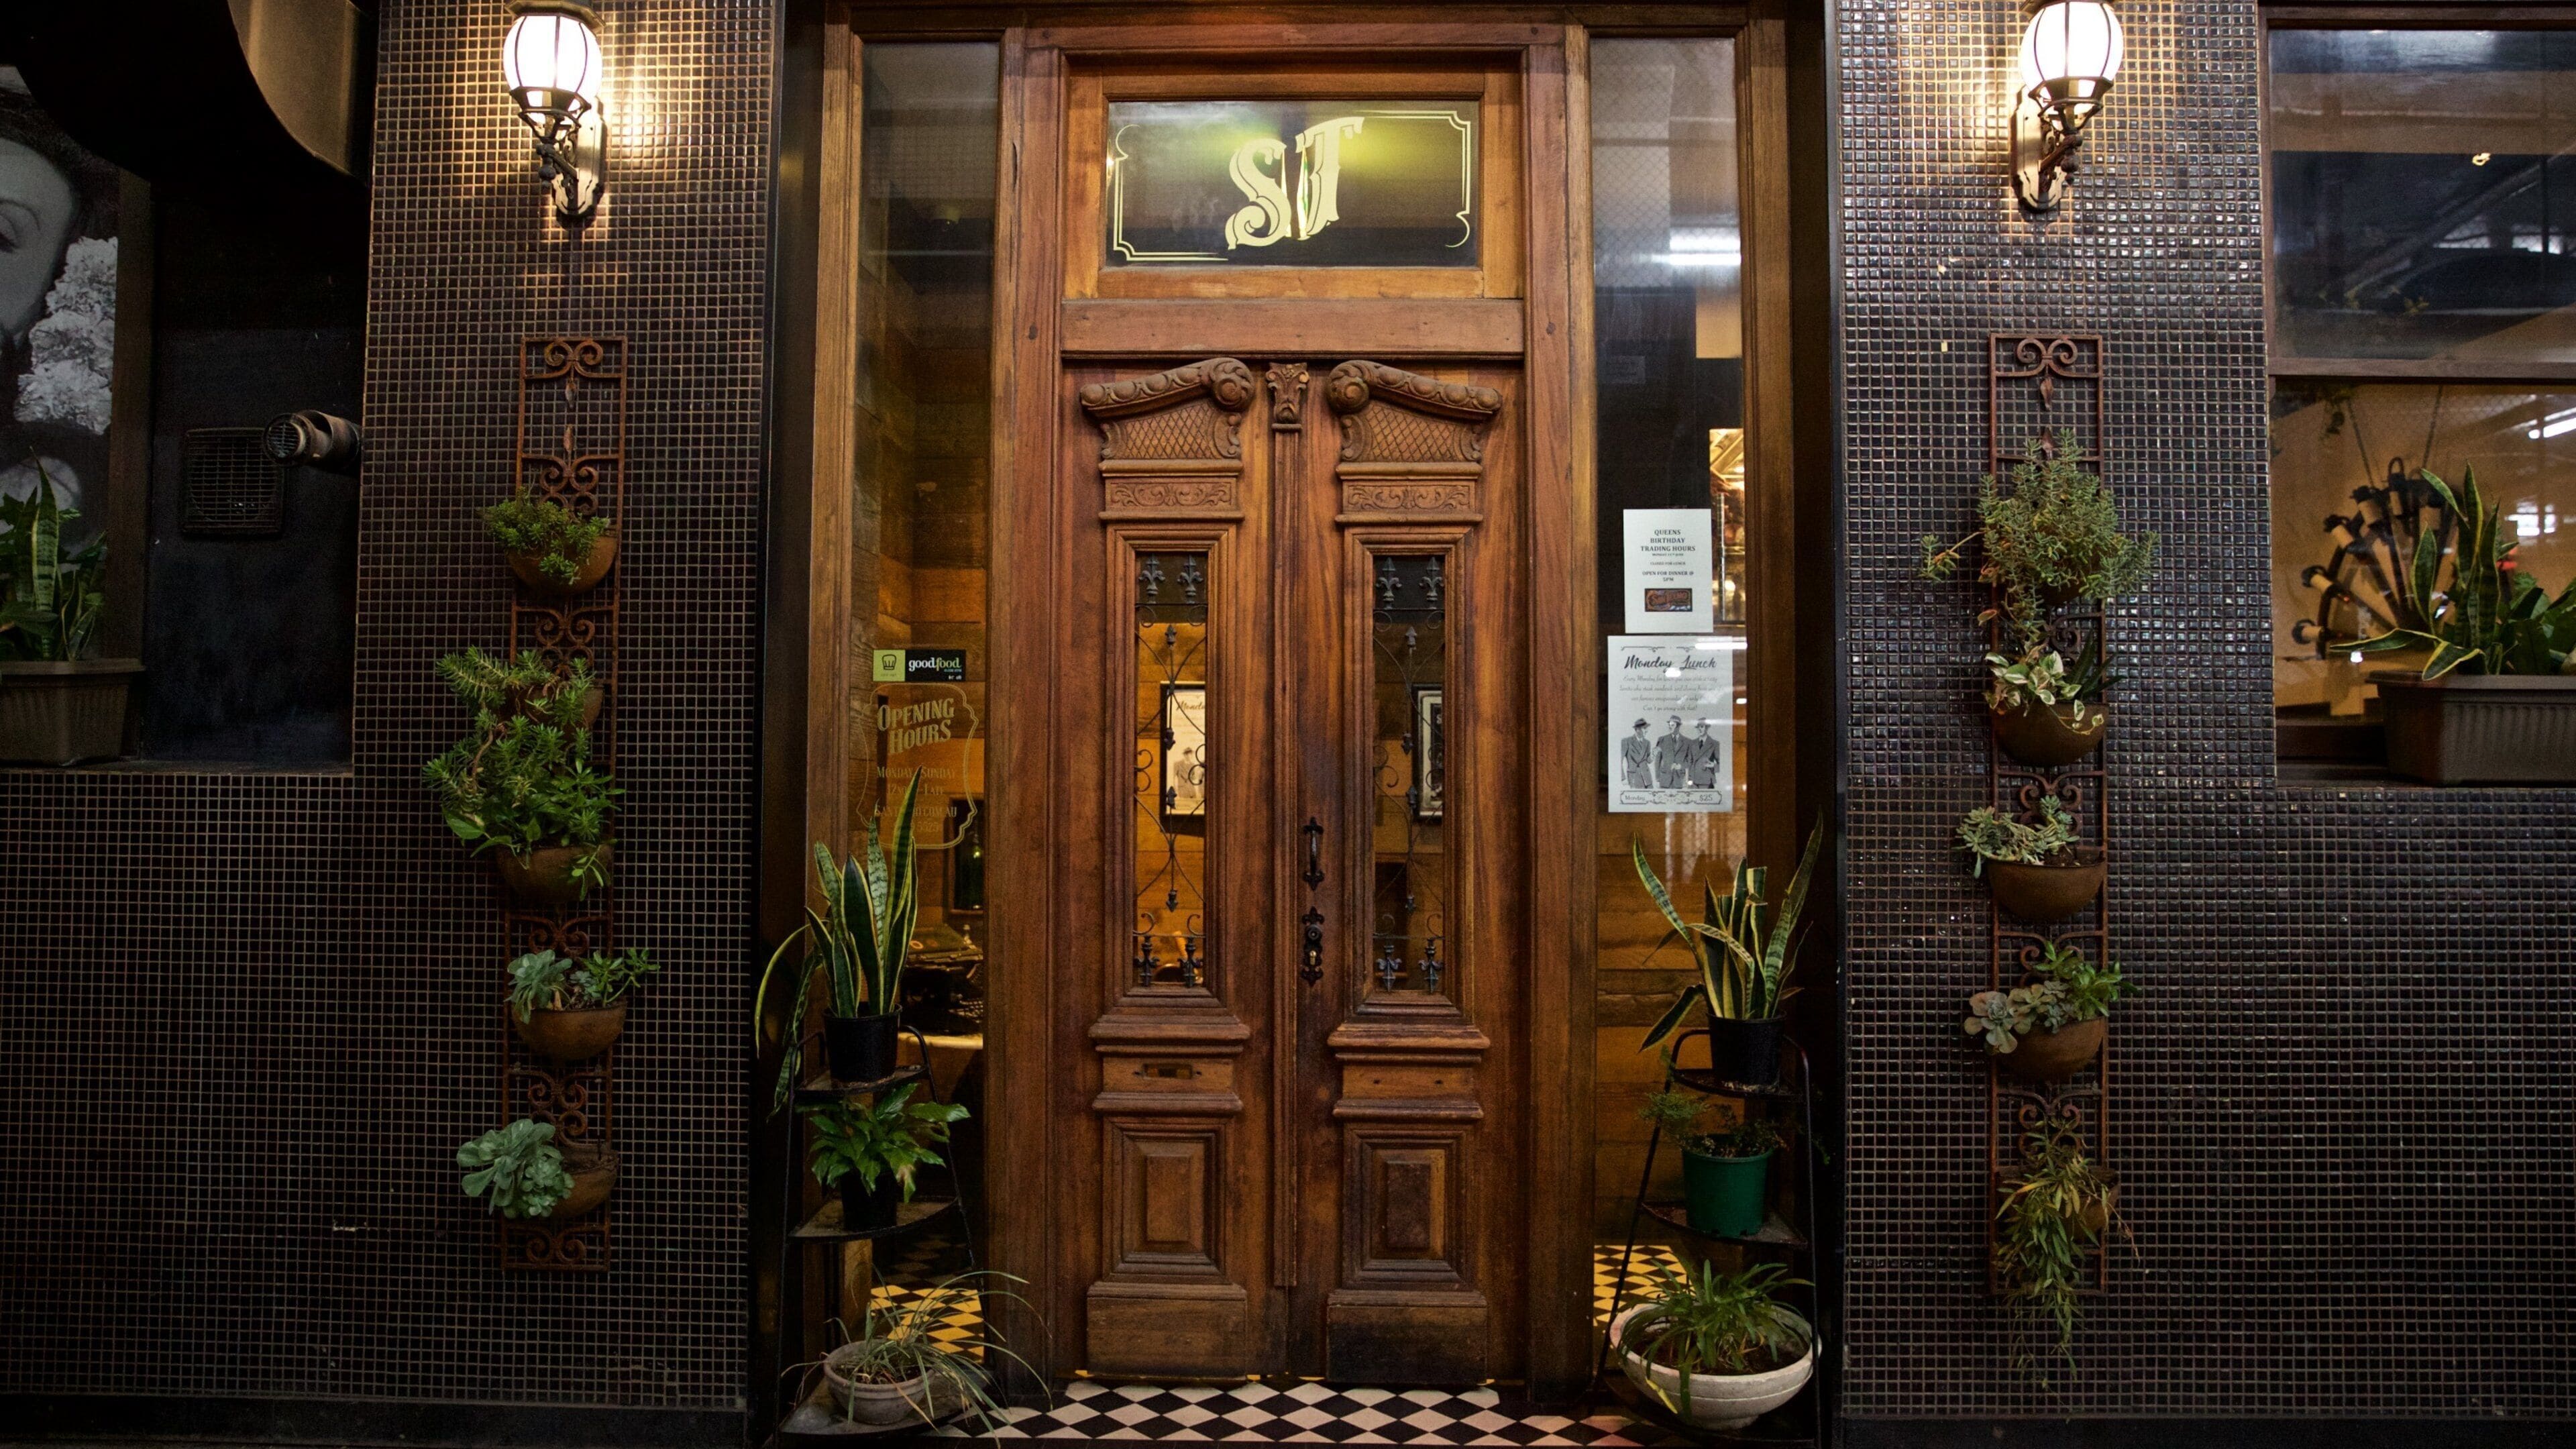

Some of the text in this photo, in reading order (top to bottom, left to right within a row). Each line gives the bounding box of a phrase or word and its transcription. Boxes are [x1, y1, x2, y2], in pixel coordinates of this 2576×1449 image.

[1624, 654, 1717, 673] Monday Lunch
[1176, 700, 1205, 711] Monda
[877, 698, 955, 731] OPENING
[889, 719, 951, 754] HOURS
[877, 766, 955, 778] MONDAY SUNDAY
[924, 784, 945, 795] LATE
[1699, 794, 1713, 802] $25
